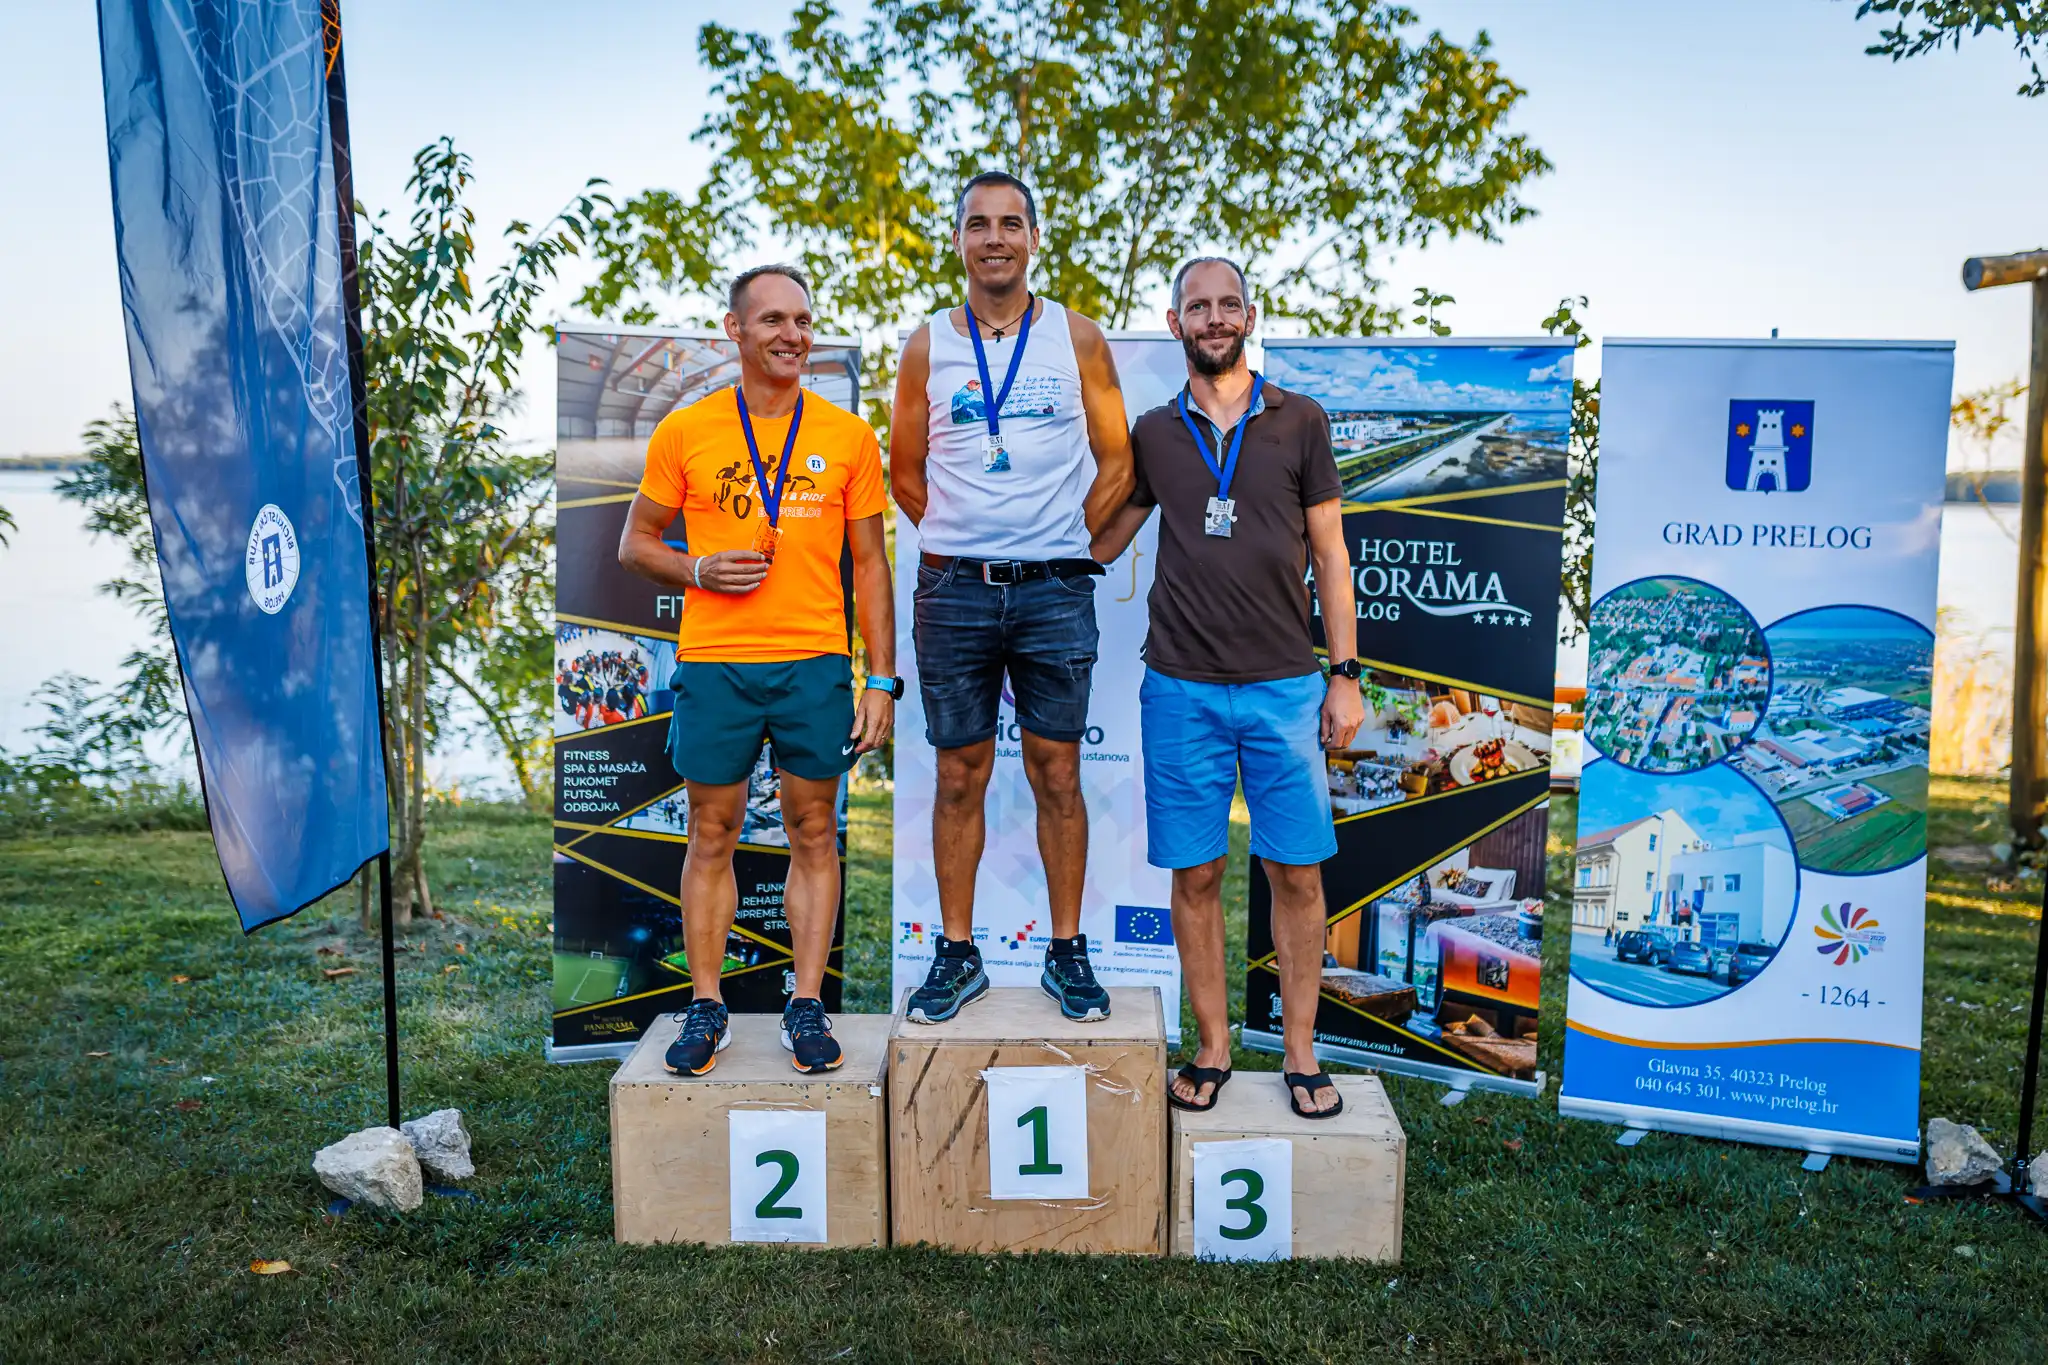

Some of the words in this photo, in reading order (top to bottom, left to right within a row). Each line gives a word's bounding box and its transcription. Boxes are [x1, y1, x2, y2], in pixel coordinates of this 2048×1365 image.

[799, 491, 827, 503] RIDE
[1662, 521, 1743, 547] GRAD
[1752, 523, 1873, 550] PRELOG
[1359, 538, 1462, 566] HOTEL
[563, 763, 586, 774] SPA
[588, 763, 596, 774] &
[599, 761, 647, 773] MASAŽA
[564, 750, 610, 761] FITNESS
[1082, 751, 1130, 762] ustanova
[563, 776, 619, 787] RUKOMET
[563, 789, 607, 800] FUTSAL
[563, 802, 621, 812] ODBOJKA
[1820, 985, 1870, 1009] 1264
[1648, 1057, 1699, 1078] Glavna
[1730, 1068, 1775, 1087] 40323
[1778, 1072, 1828, 1096] Prelog
[1635, 1075, 1662, 1092] 040
[1665, 1080, 1692, 1096] 645
[1730, 1089, 1840, 1116] www.prelog.hr
[1016, 1105, 1064, 1176] 1
[754, 1148, 804, 1220] 2
[1217, 1168, 1269, 1241] 3
